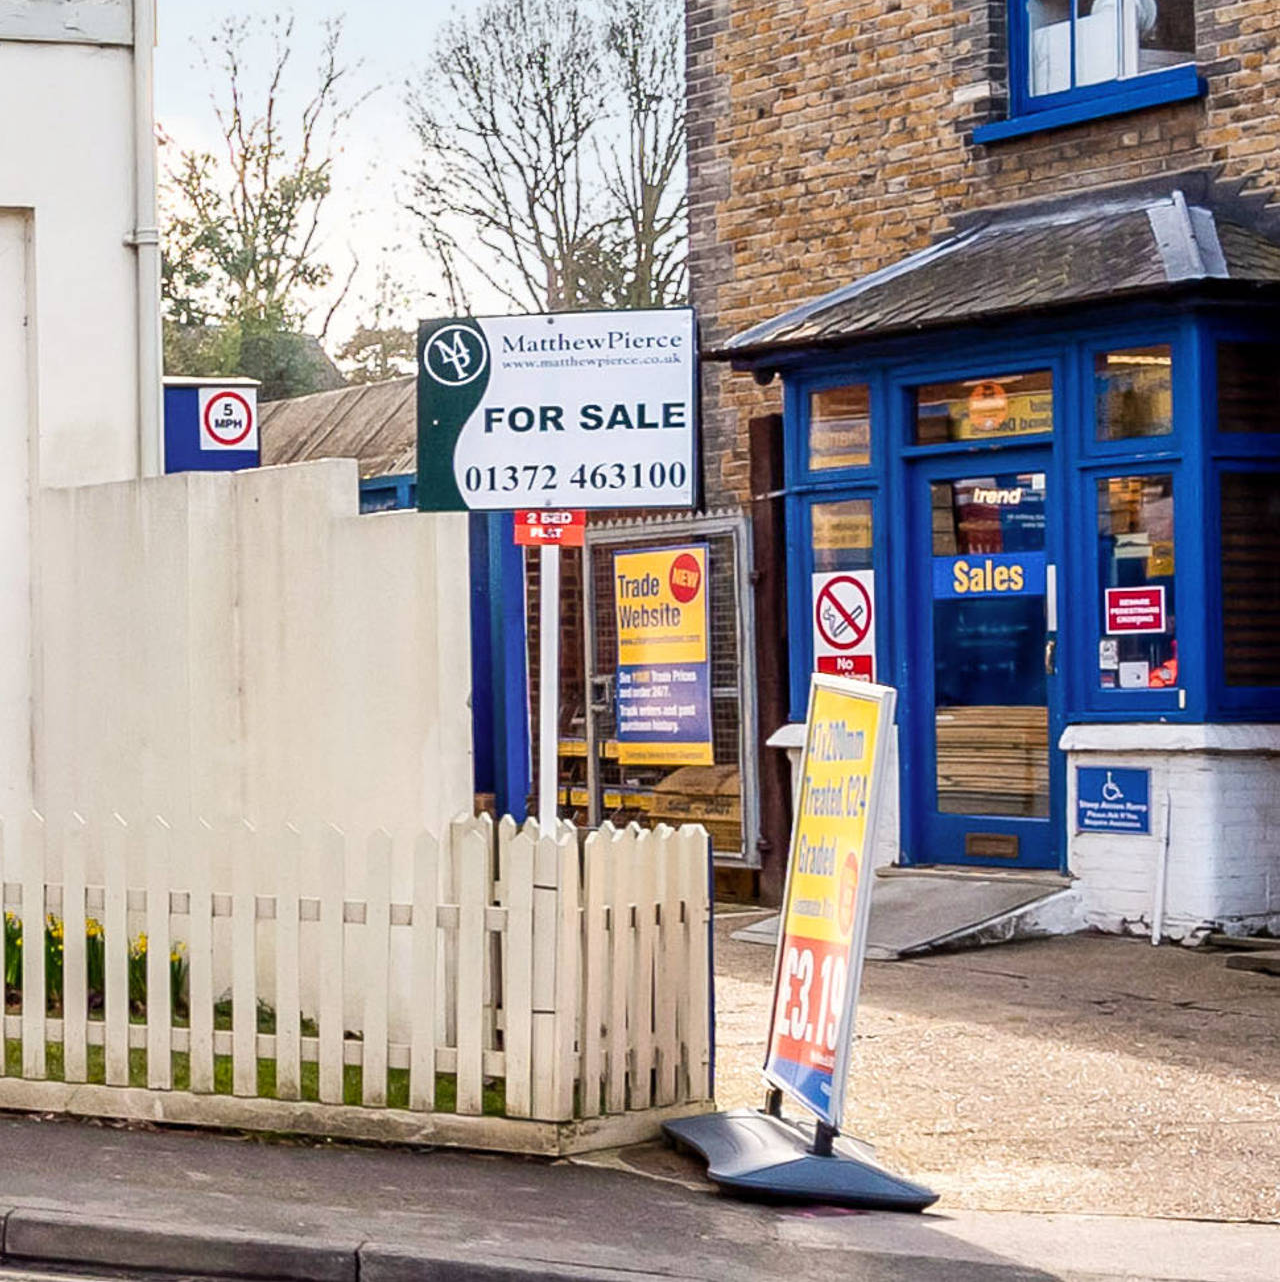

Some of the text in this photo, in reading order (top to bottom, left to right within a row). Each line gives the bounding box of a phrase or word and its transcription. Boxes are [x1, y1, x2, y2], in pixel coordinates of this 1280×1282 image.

[502, 331, 683, 353] MatthewPierce
[502, 353, 682, 369] www.matthewpierce.co.uk
[223, 403, 233, 417] 5
[485, 403, 686, 433] FOR SALE
[214, 419, 242, 429] MPH
[465, 461, 686, 492] 01372 463100
[972, 487, 1023, 505] trend
[526, 512, 572, 524] 2 BED
[530, 527, 563, 538] FLAT
[618, 573, 660, 599] Trade
[672, 569, 699, 588] NEW
[953, 560, 1024, 594] Sales
[619, 603, 681, 629] Website
[837, 657, 854, 670] No
[797, 834, 837, 876] Graded
[777, 946, 846, 1051] £3.19
